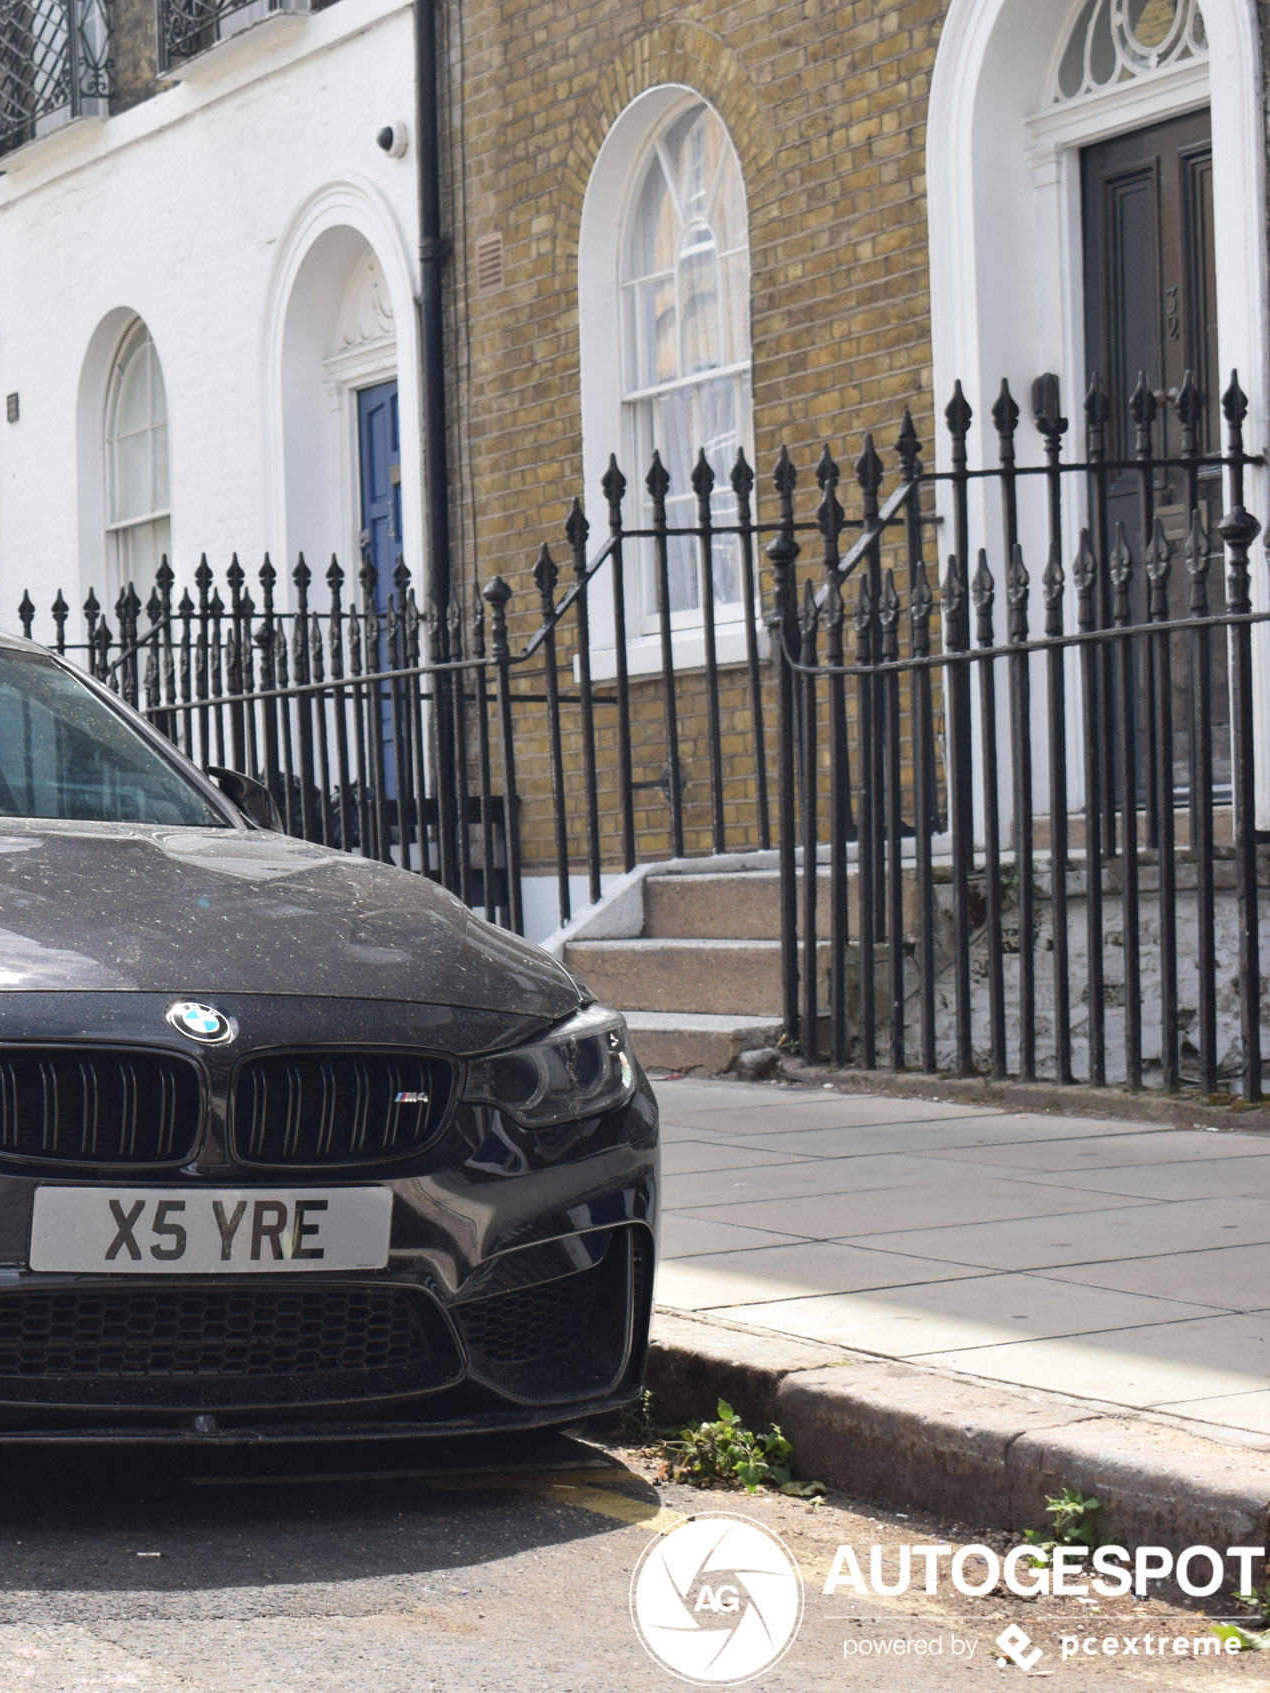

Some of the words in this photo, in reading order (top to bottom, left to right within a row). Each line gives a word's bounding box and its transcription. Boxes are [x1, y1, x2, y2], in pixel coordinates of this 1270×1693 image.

[1165, 286, 1179, 343] 32
[104, 1199, 187, 1261] X5
[212, 1199, 329, 1261] YRE
